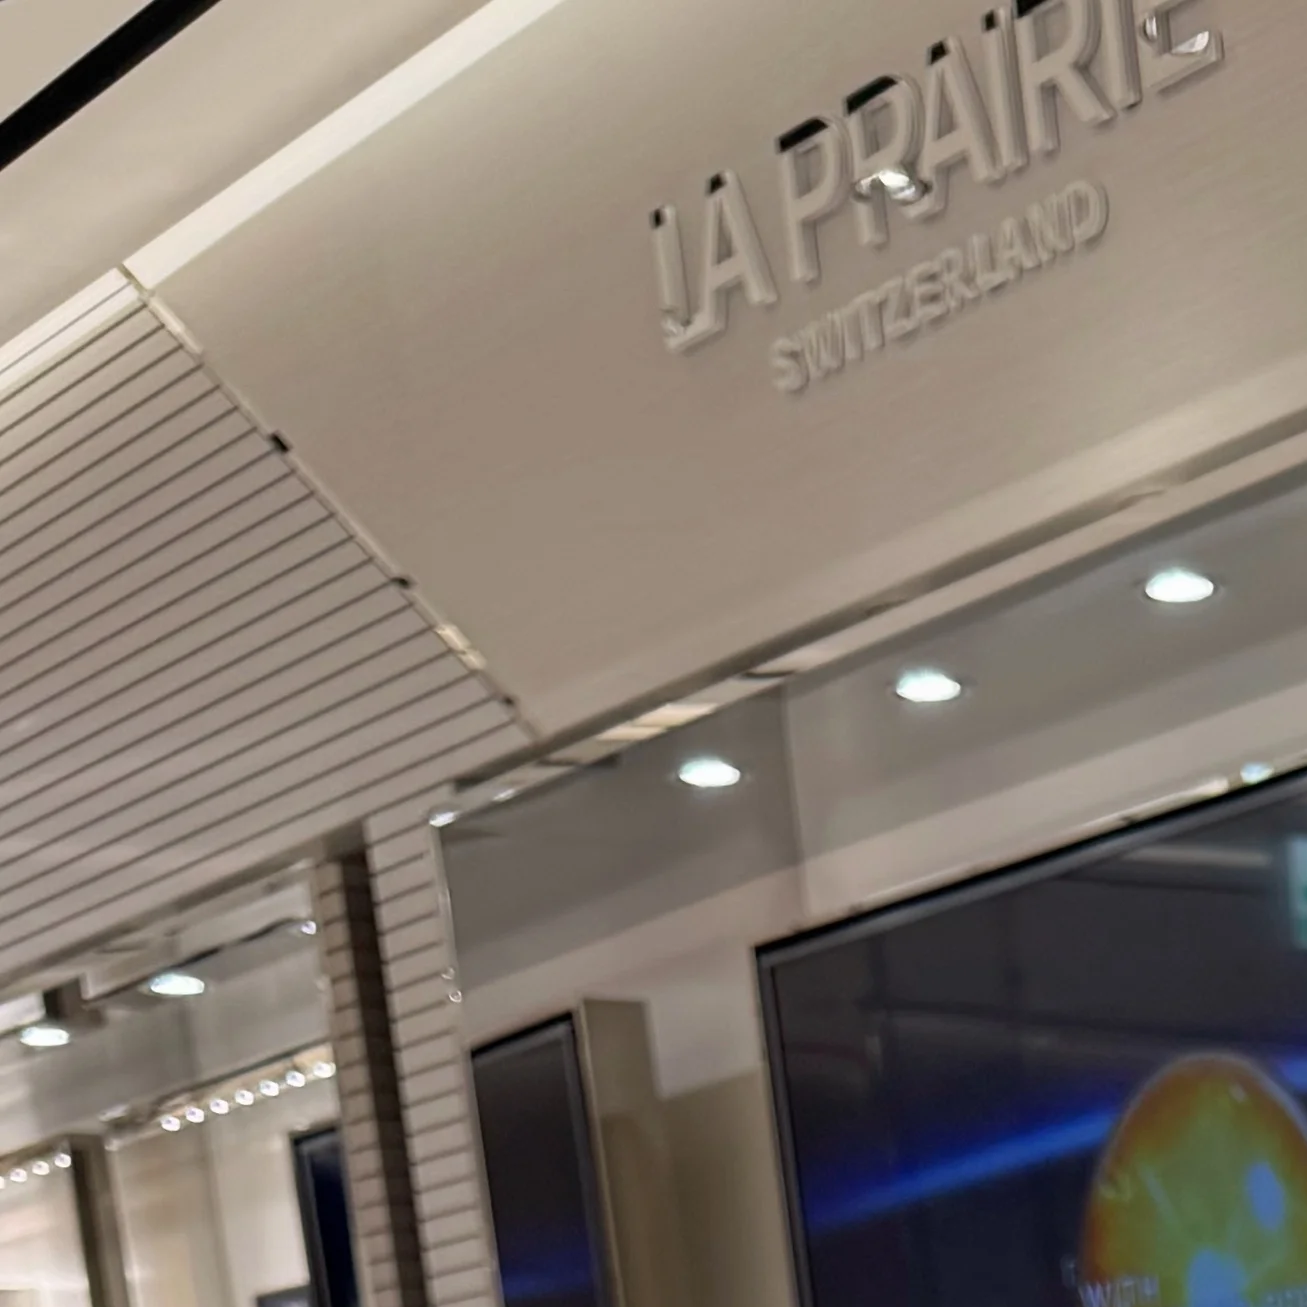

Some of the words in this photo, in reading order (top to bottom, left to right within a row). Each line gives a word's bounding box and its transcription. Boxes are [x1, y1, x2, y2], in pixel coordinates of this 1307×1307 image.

[649, 169, 778, 353] LA
[776, 0, 1223, 283] PRAIRIE
[769, 180, 1110, 393] SWITZERLAND
